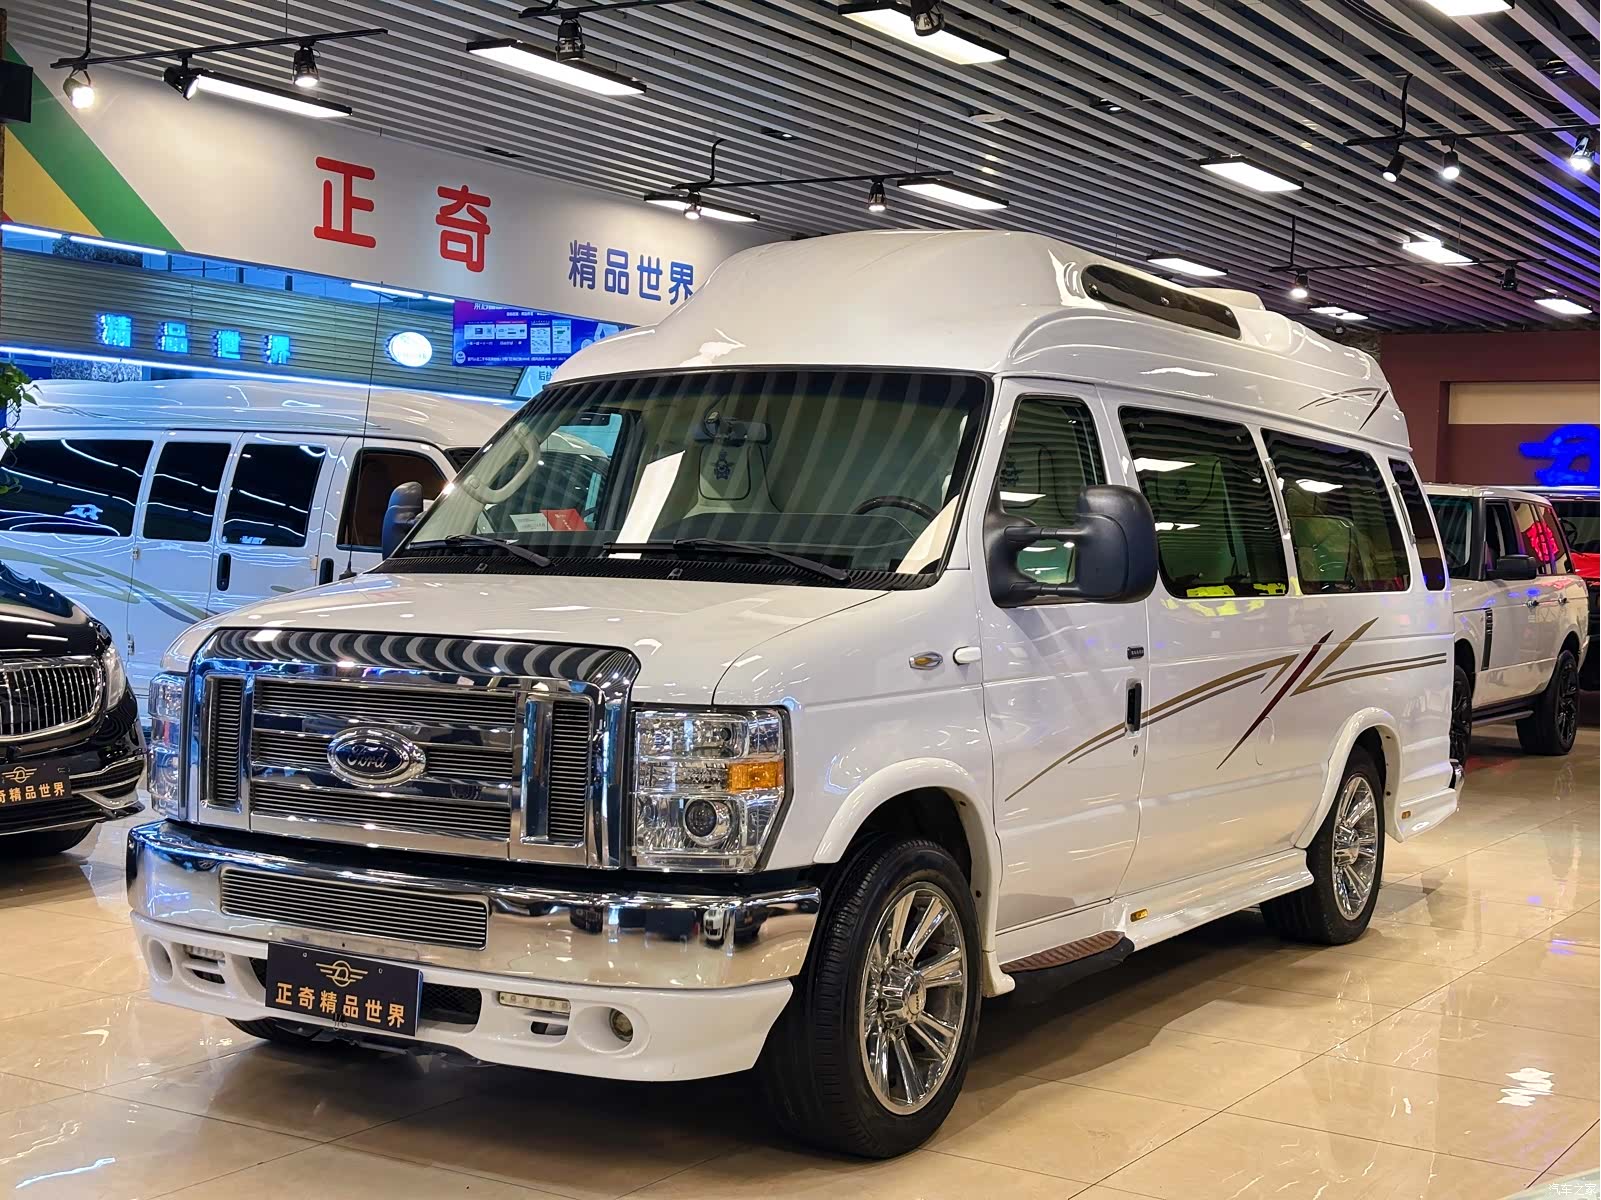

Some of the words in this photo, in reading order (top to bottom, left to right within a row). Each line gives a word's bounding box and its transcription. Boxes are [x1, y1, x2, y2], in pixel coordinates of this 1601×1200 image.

[313, 156, 492, 273] 正奇
[568, 240, 694, 305] 精品世界
[347, 744, 389, 768] Ford
[275, 982, 405, 1029] 正奇精品世界
